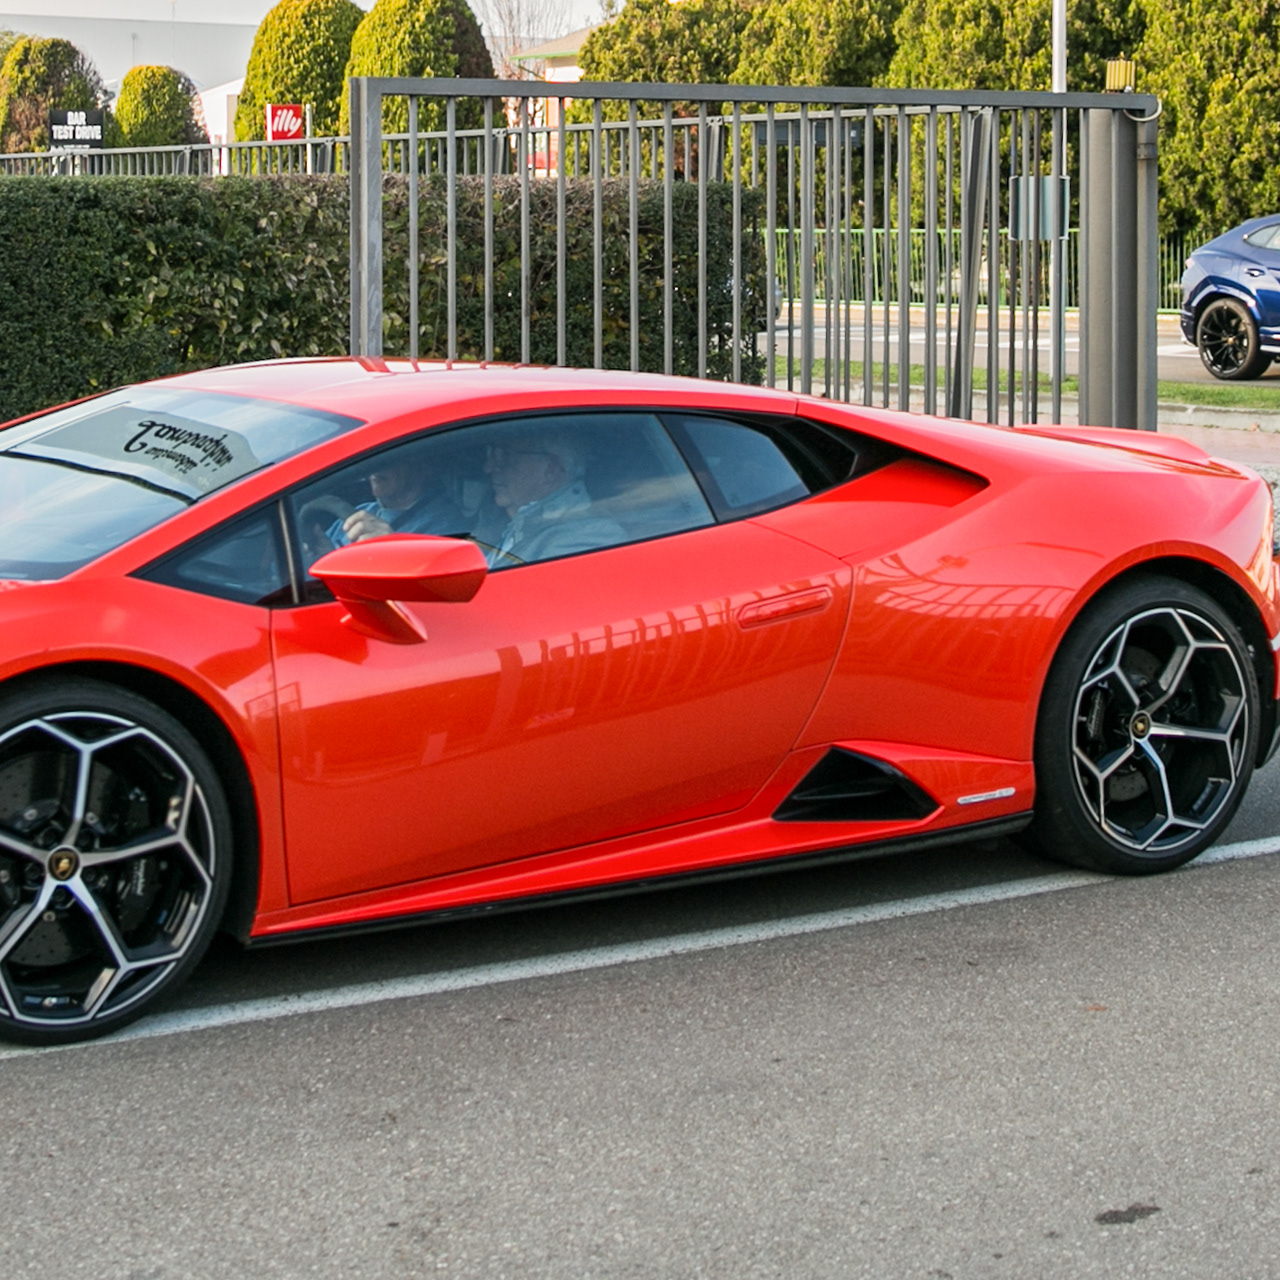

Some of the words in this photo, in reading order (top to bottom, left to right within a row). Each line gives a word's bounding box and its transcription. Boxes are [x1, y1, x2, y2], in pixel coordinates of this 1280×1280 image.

[67, 111, 87, 125] BAR
[272, 108, 302, 137] illy
[51, 125, 75, 140] TEST
[75, 125, 102, 140] DRIVE
